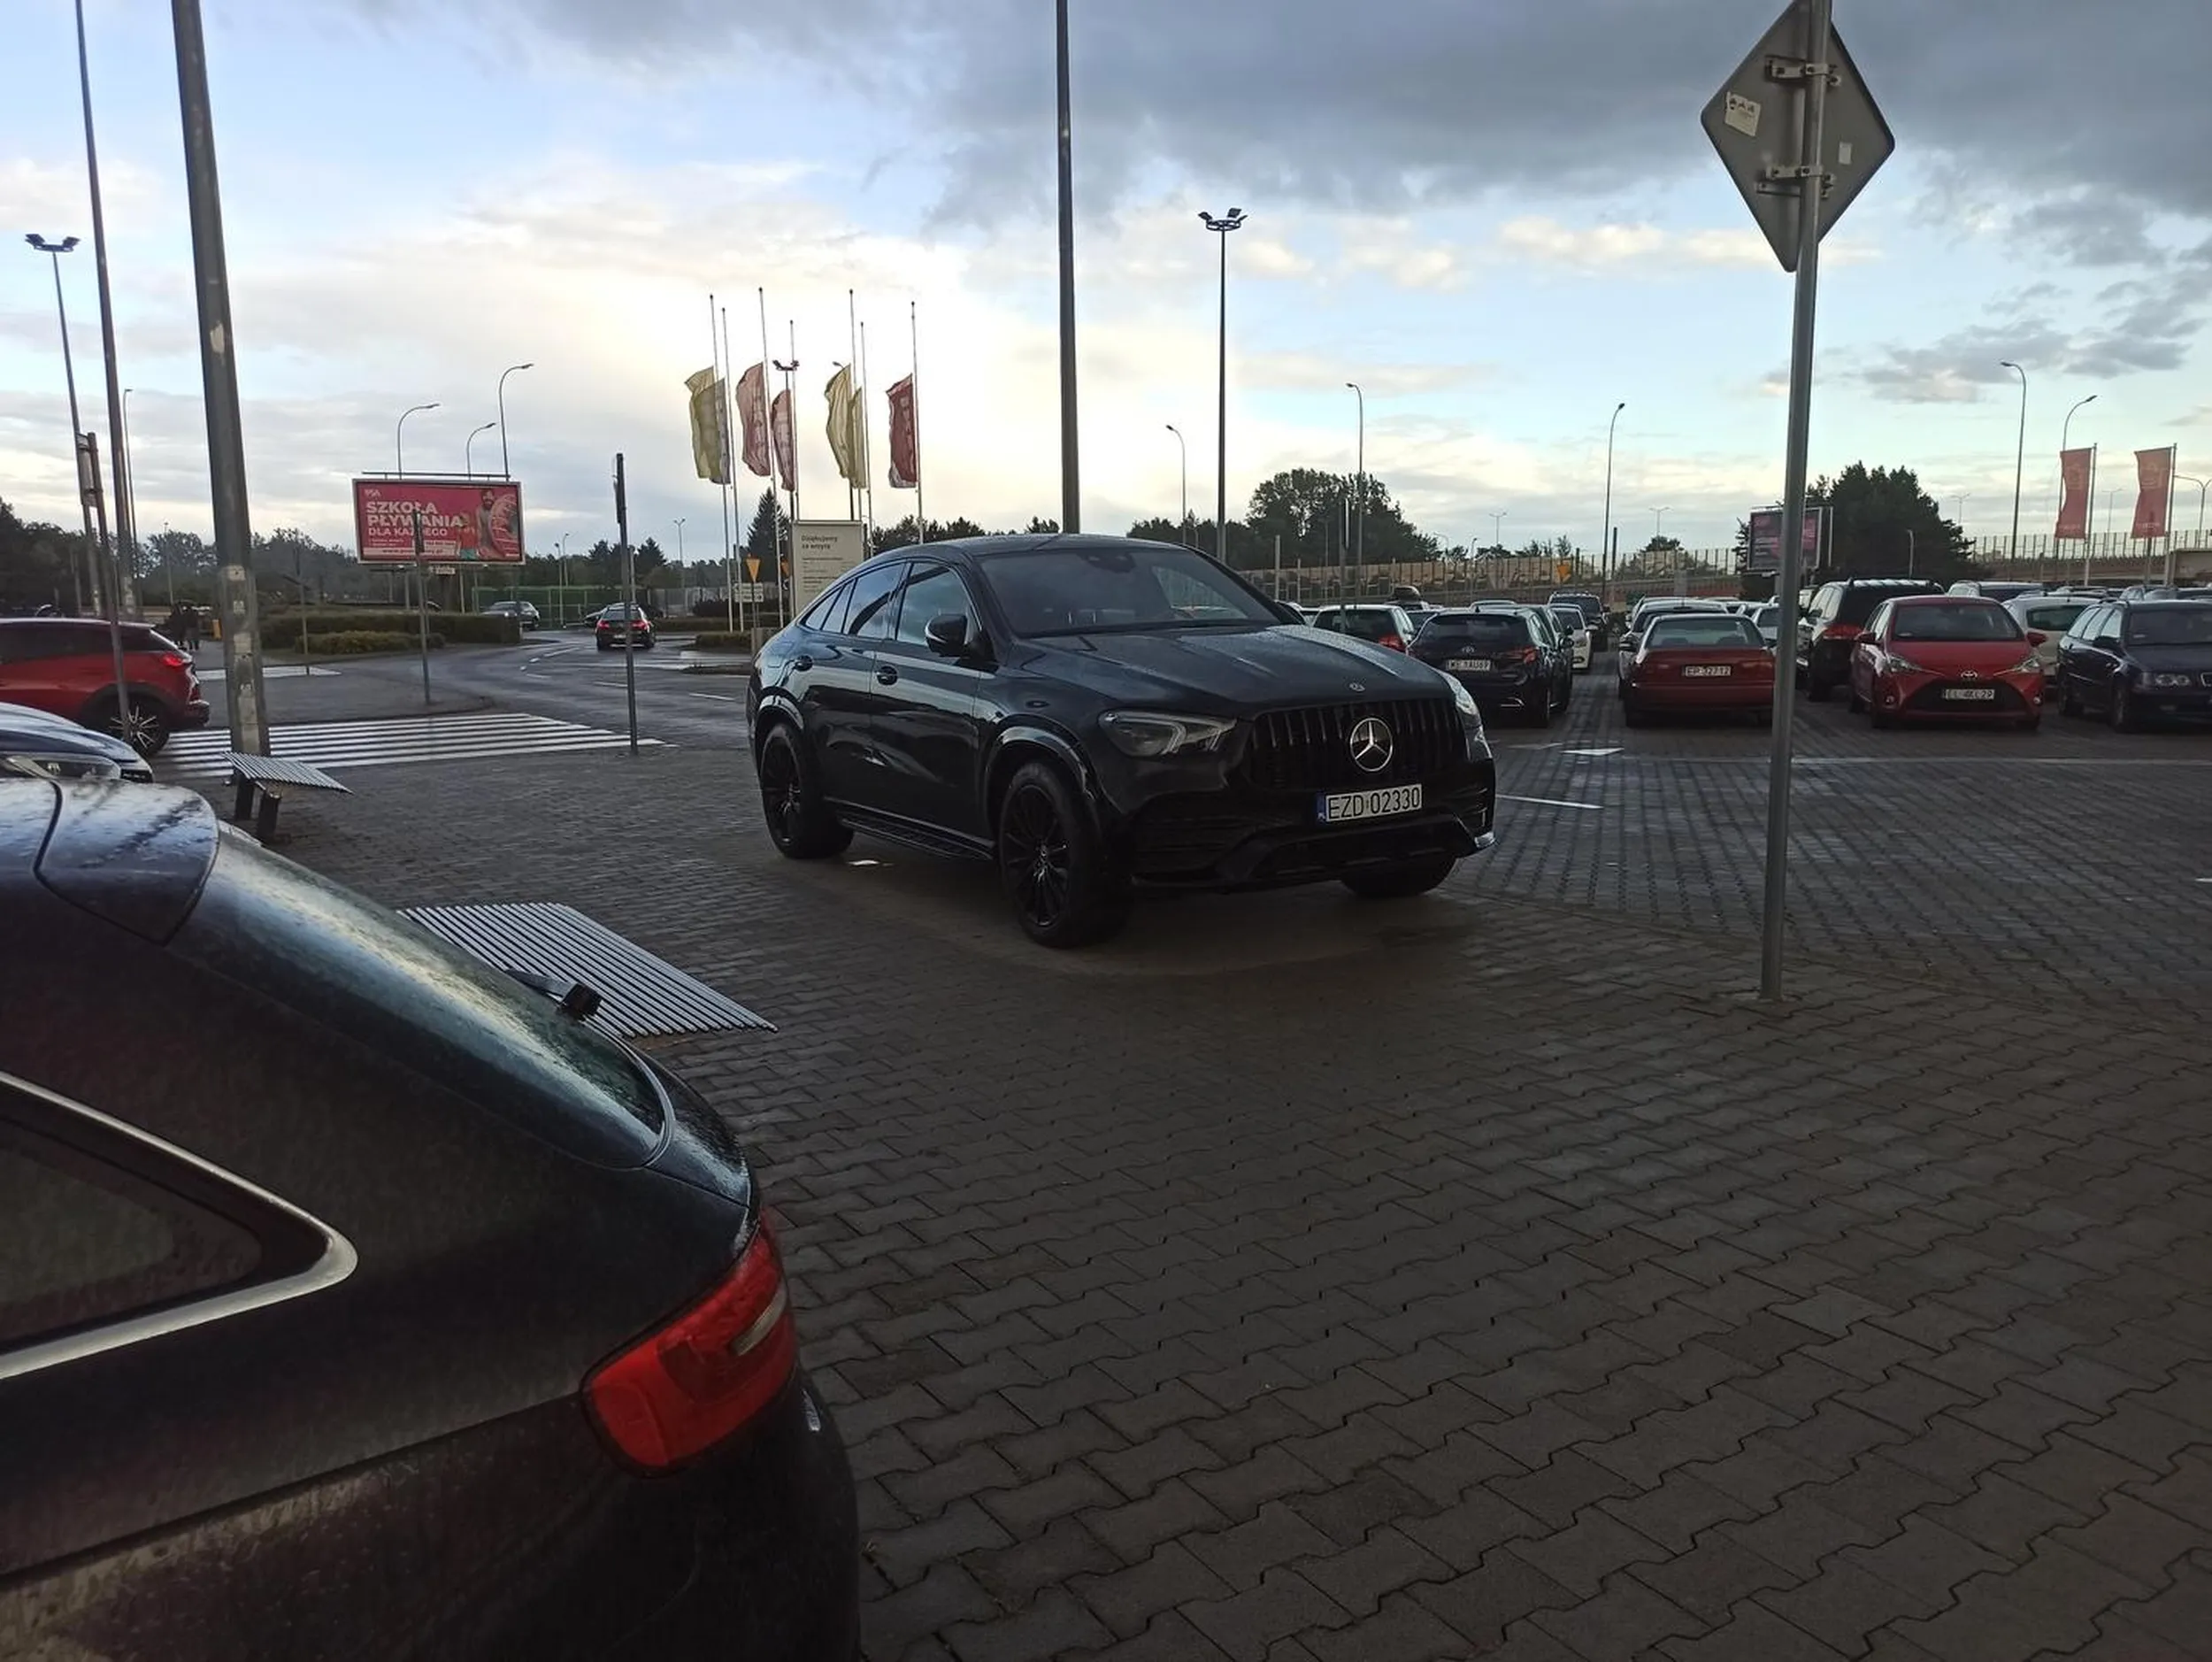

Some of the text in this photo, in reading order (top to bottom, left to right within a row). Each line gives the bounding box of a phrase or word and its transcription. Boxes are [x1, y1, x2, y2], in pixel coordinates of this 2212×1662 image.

[365, 501, 438, 514] SZKOŁA
[368, 527, 390, 536] DLA
[1329, 787, 1420, 819] EZD 02330
